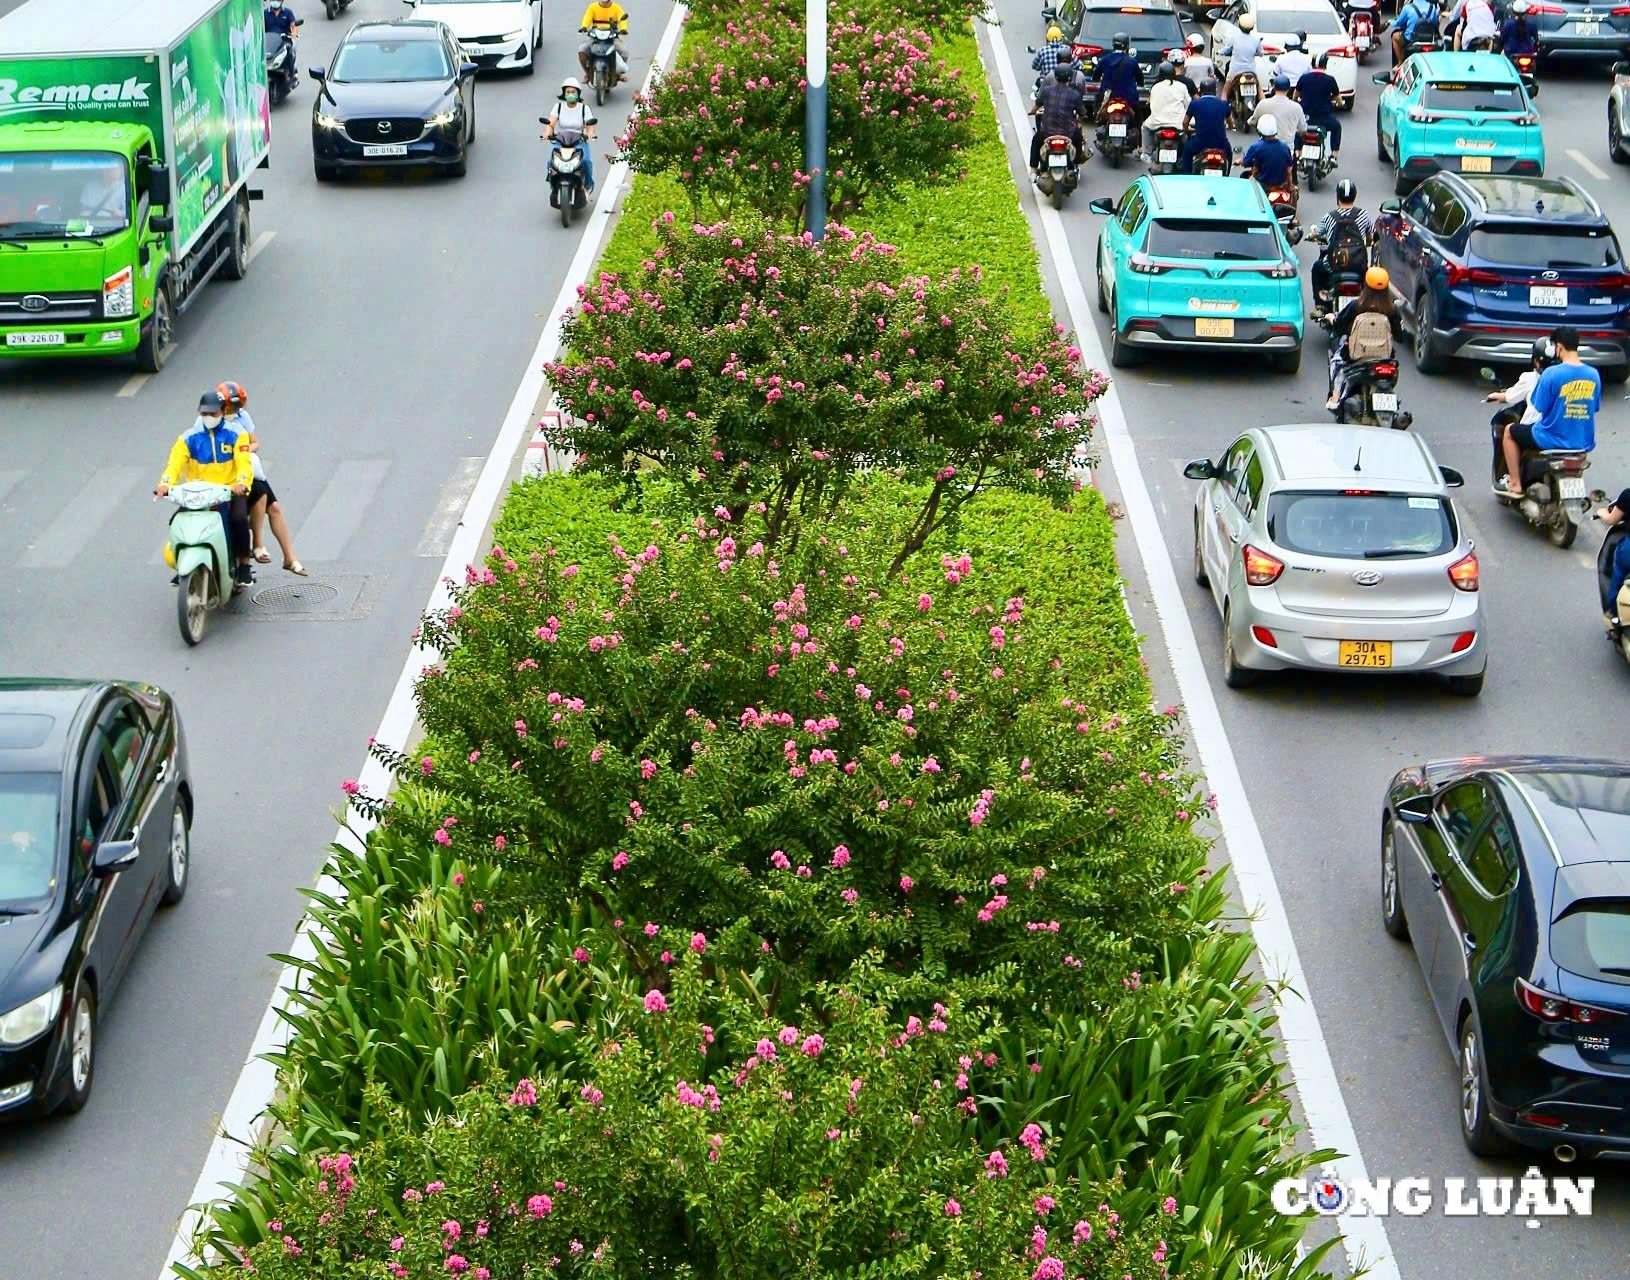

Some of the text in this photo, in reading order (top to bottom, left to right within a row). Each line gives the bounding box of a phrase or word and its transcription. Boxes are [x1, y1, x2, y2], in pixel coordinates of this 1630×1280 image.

[0, 76, 152, 104] Remak
[77, 102, 102, 110] Quality
[103, 102, 117, 110] you
[1541, 288, 1556, 297] 30K
[1534, 297, 1564, 306] 033.75
[1206, 319, 1223, 328] 99E
[1200, 327, 1230, 336] 007.50
[12, 334, 60, 343] 29K-226.07
[1355, 642, 1377, 654] 30A
[1345, 654, 1386, 666] 297.15
[1583, 1042, 1610, 1050] SPORT
